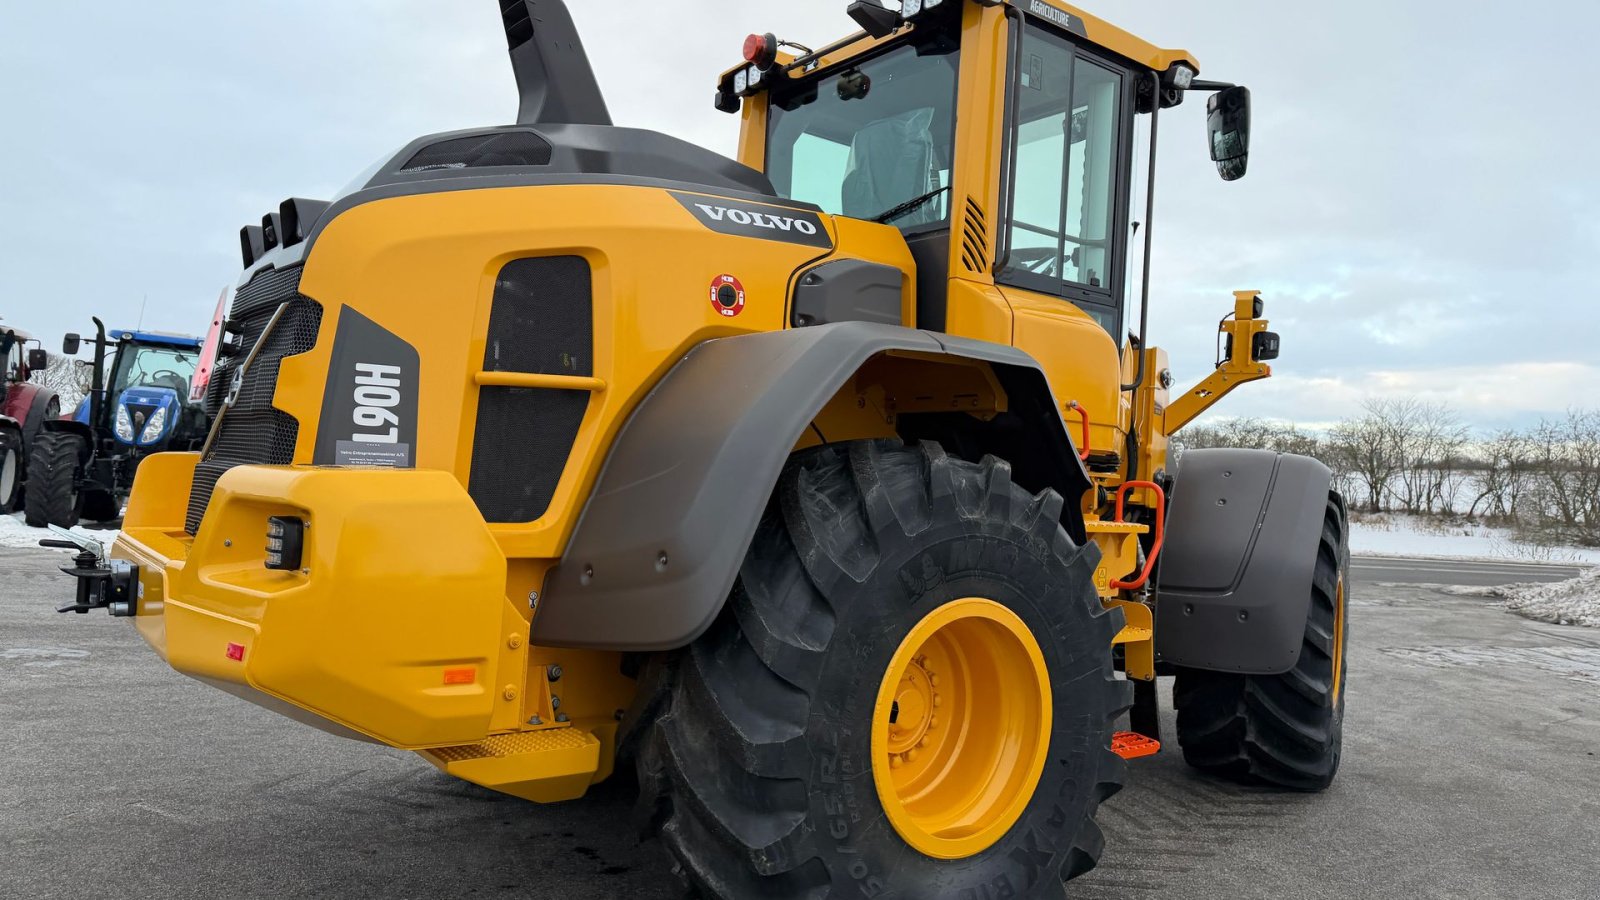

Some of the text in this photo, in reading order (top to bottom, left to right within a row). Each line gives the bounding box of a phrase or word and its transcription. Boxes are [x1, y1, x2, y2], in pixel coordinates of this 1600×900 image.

[1030, 0, 1069, 26] AGRICULTURE
[694, 203, 817, 235] VOLVO
[352, 362, 401, 443] L90H
